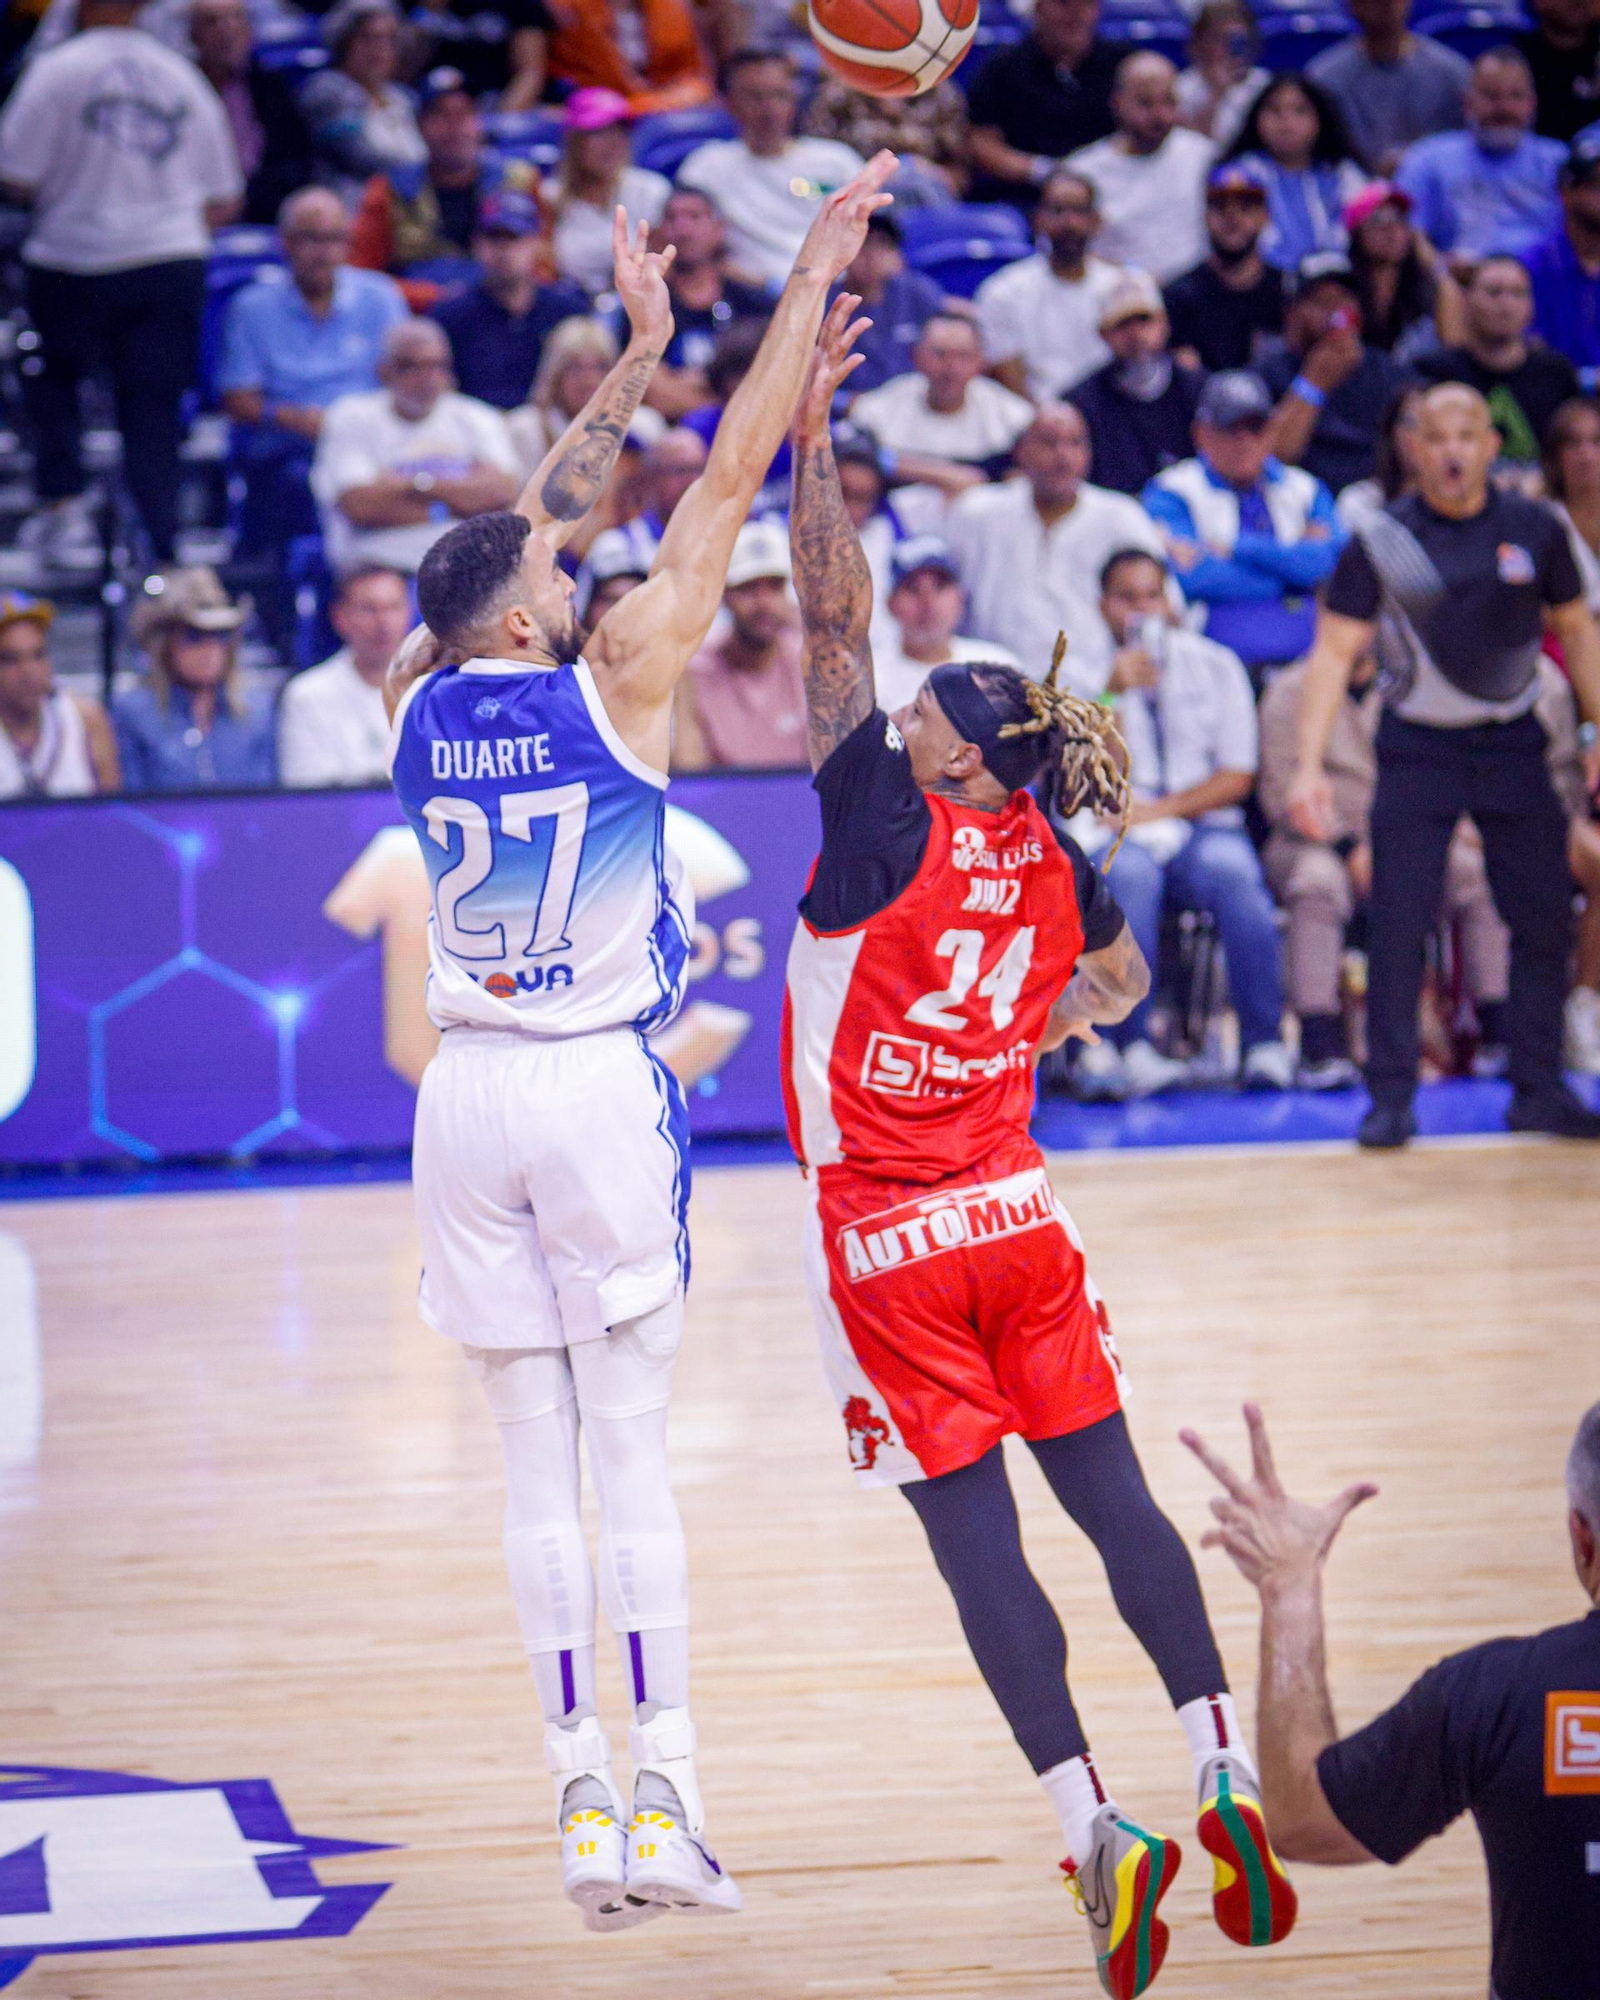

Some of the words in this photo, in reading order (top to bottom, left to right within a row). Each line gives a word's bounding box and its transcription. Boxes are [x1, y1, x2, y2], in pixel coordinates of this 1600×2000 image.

[431, 733, 555, 780] DUARTE
[421, 780, 590, 961] 27
[903, 925, 1036, 1031] 24
